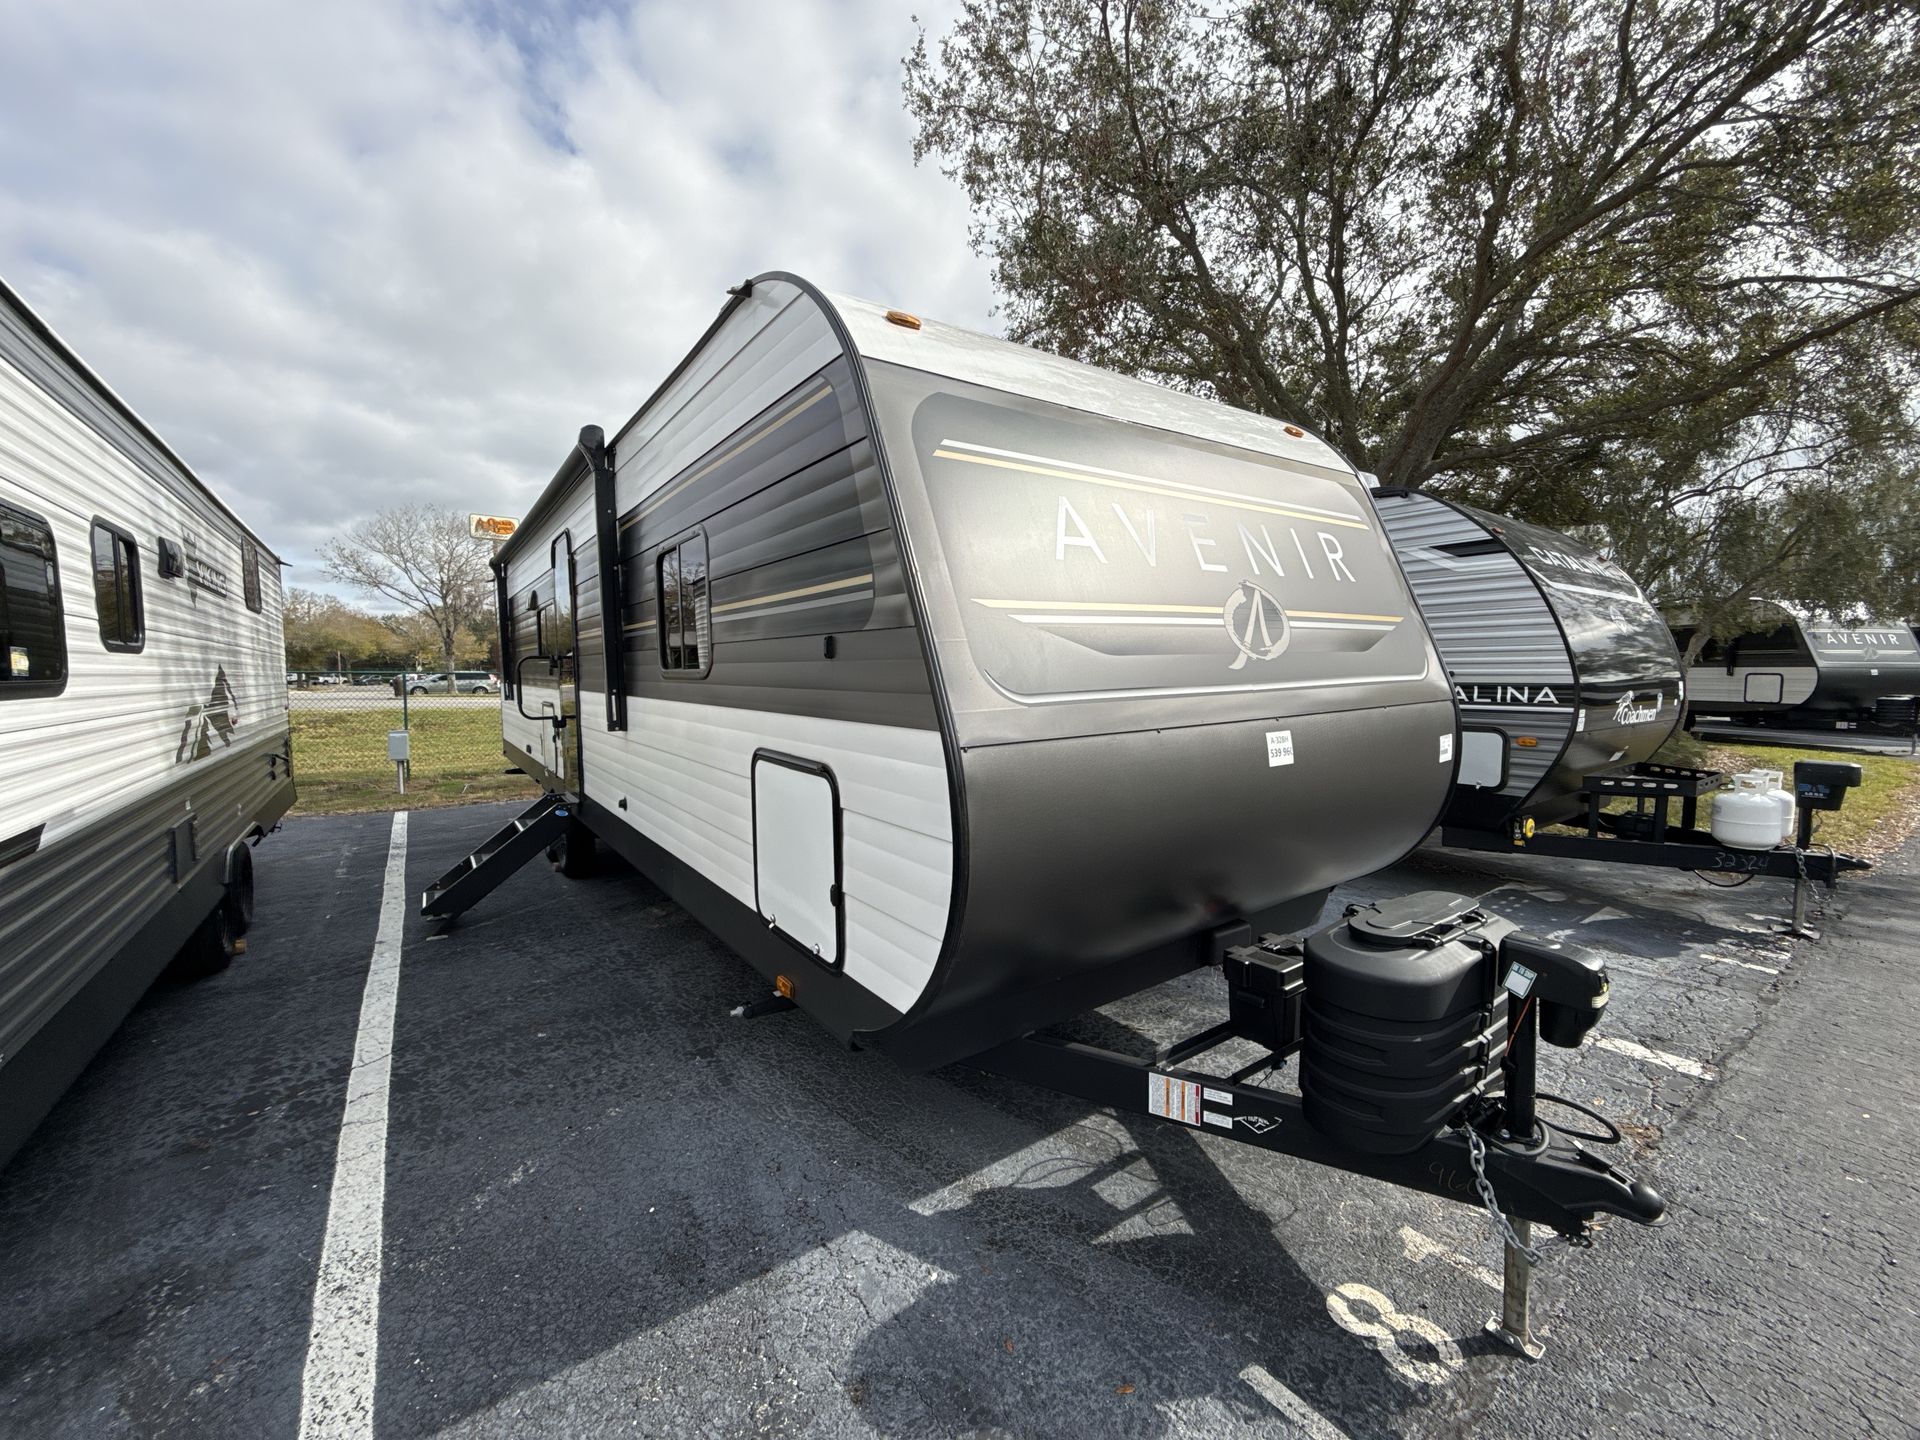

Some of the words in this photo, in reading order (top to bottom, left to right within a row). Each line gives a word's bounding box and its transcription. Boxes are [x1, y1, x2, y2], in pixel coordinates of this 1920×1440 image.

[1055, 496, 1357, 583] AVENIR
[1527, 545, 1613, 578] CATALIN
[1826, 633, 1900, 645] AVENIR
[1620, 704, 1658, 725] Coachmen
